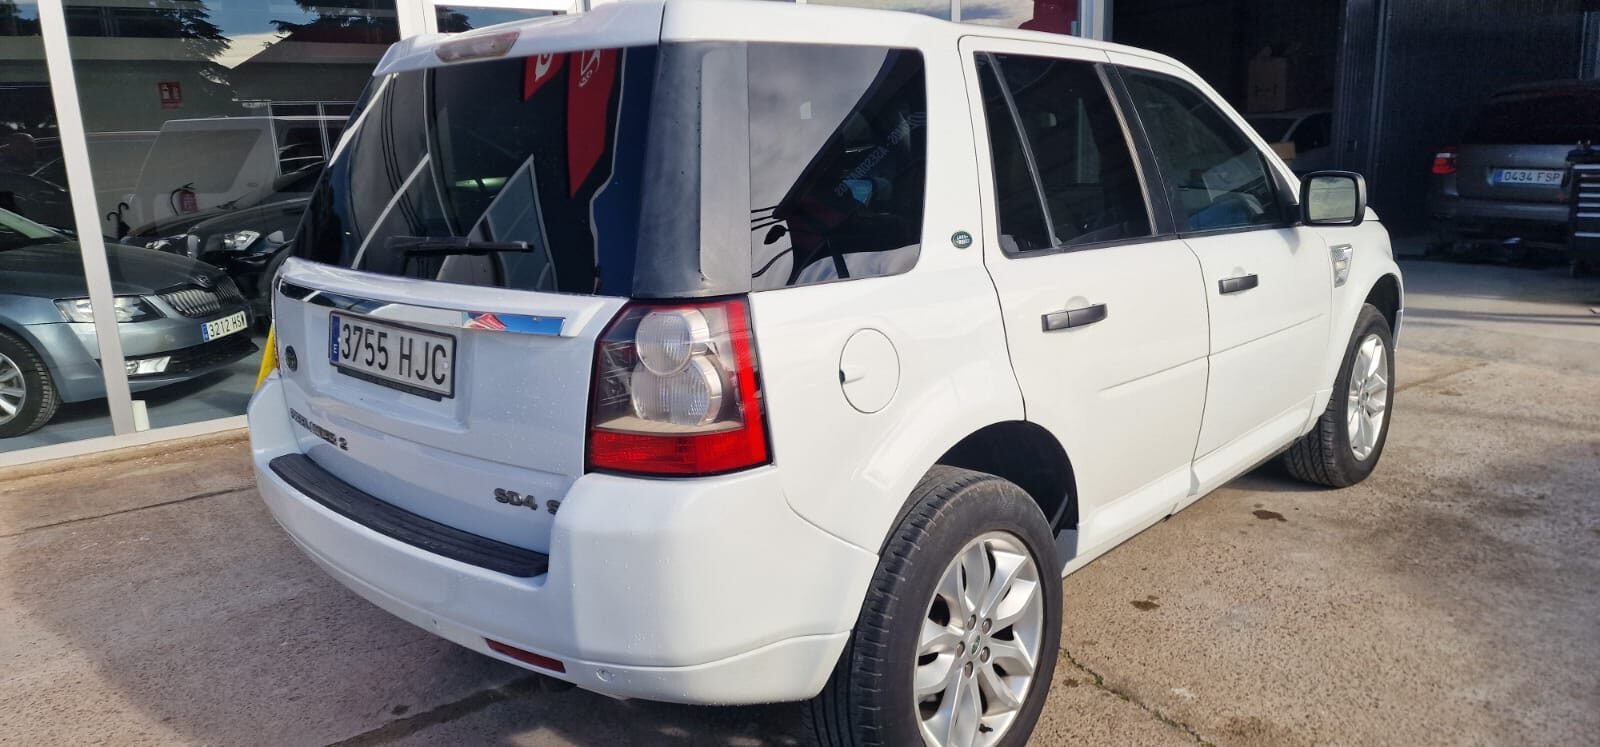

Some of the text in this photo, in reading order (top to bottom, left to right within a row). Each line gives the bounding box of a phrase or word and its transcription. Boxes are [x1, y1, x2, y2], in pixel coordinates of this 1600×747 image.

[1504, 171, 1561, 182] 0434 FSP
[209, 319, 231, 337] 3212
[342, 323, 389, 370] 3755
[399, 336, 447, 385] HJC
[339, 437, 349, 451] 2
[494, 488, 539, 511] SD4
